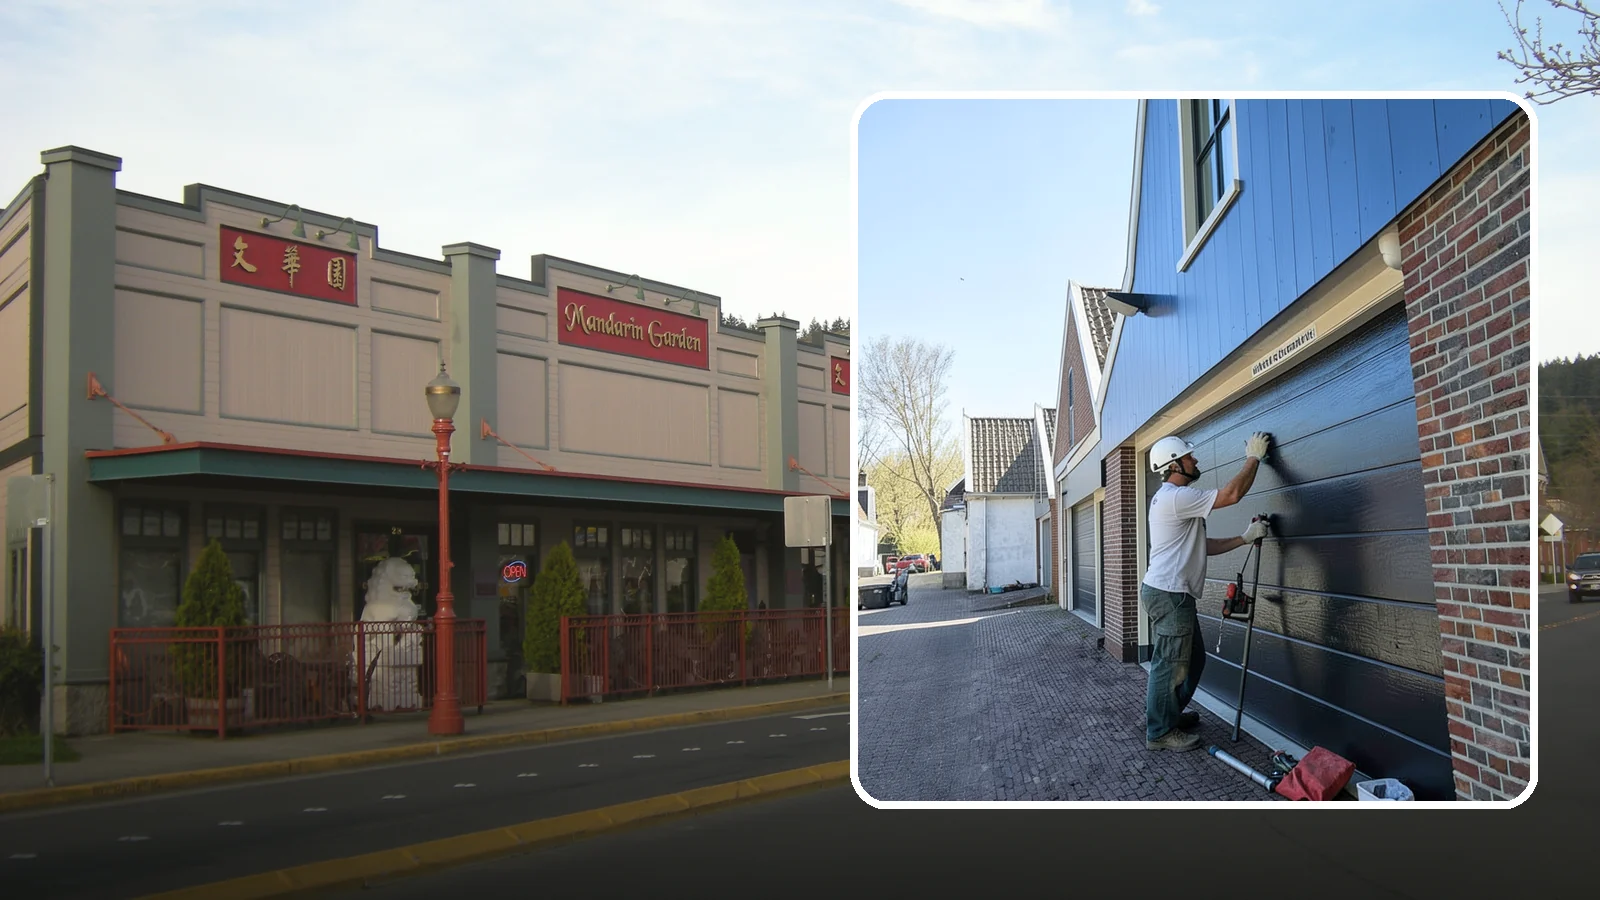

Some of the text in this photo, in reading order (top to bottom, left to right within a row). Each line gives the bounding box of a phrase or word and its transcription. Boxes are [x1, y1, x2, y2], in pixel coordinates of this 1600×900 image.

[231, 236, 346, 291] 文華園
[565, 302, 701, 352] Mandarin Garden
[503, 565, 527, 578] OPEN
